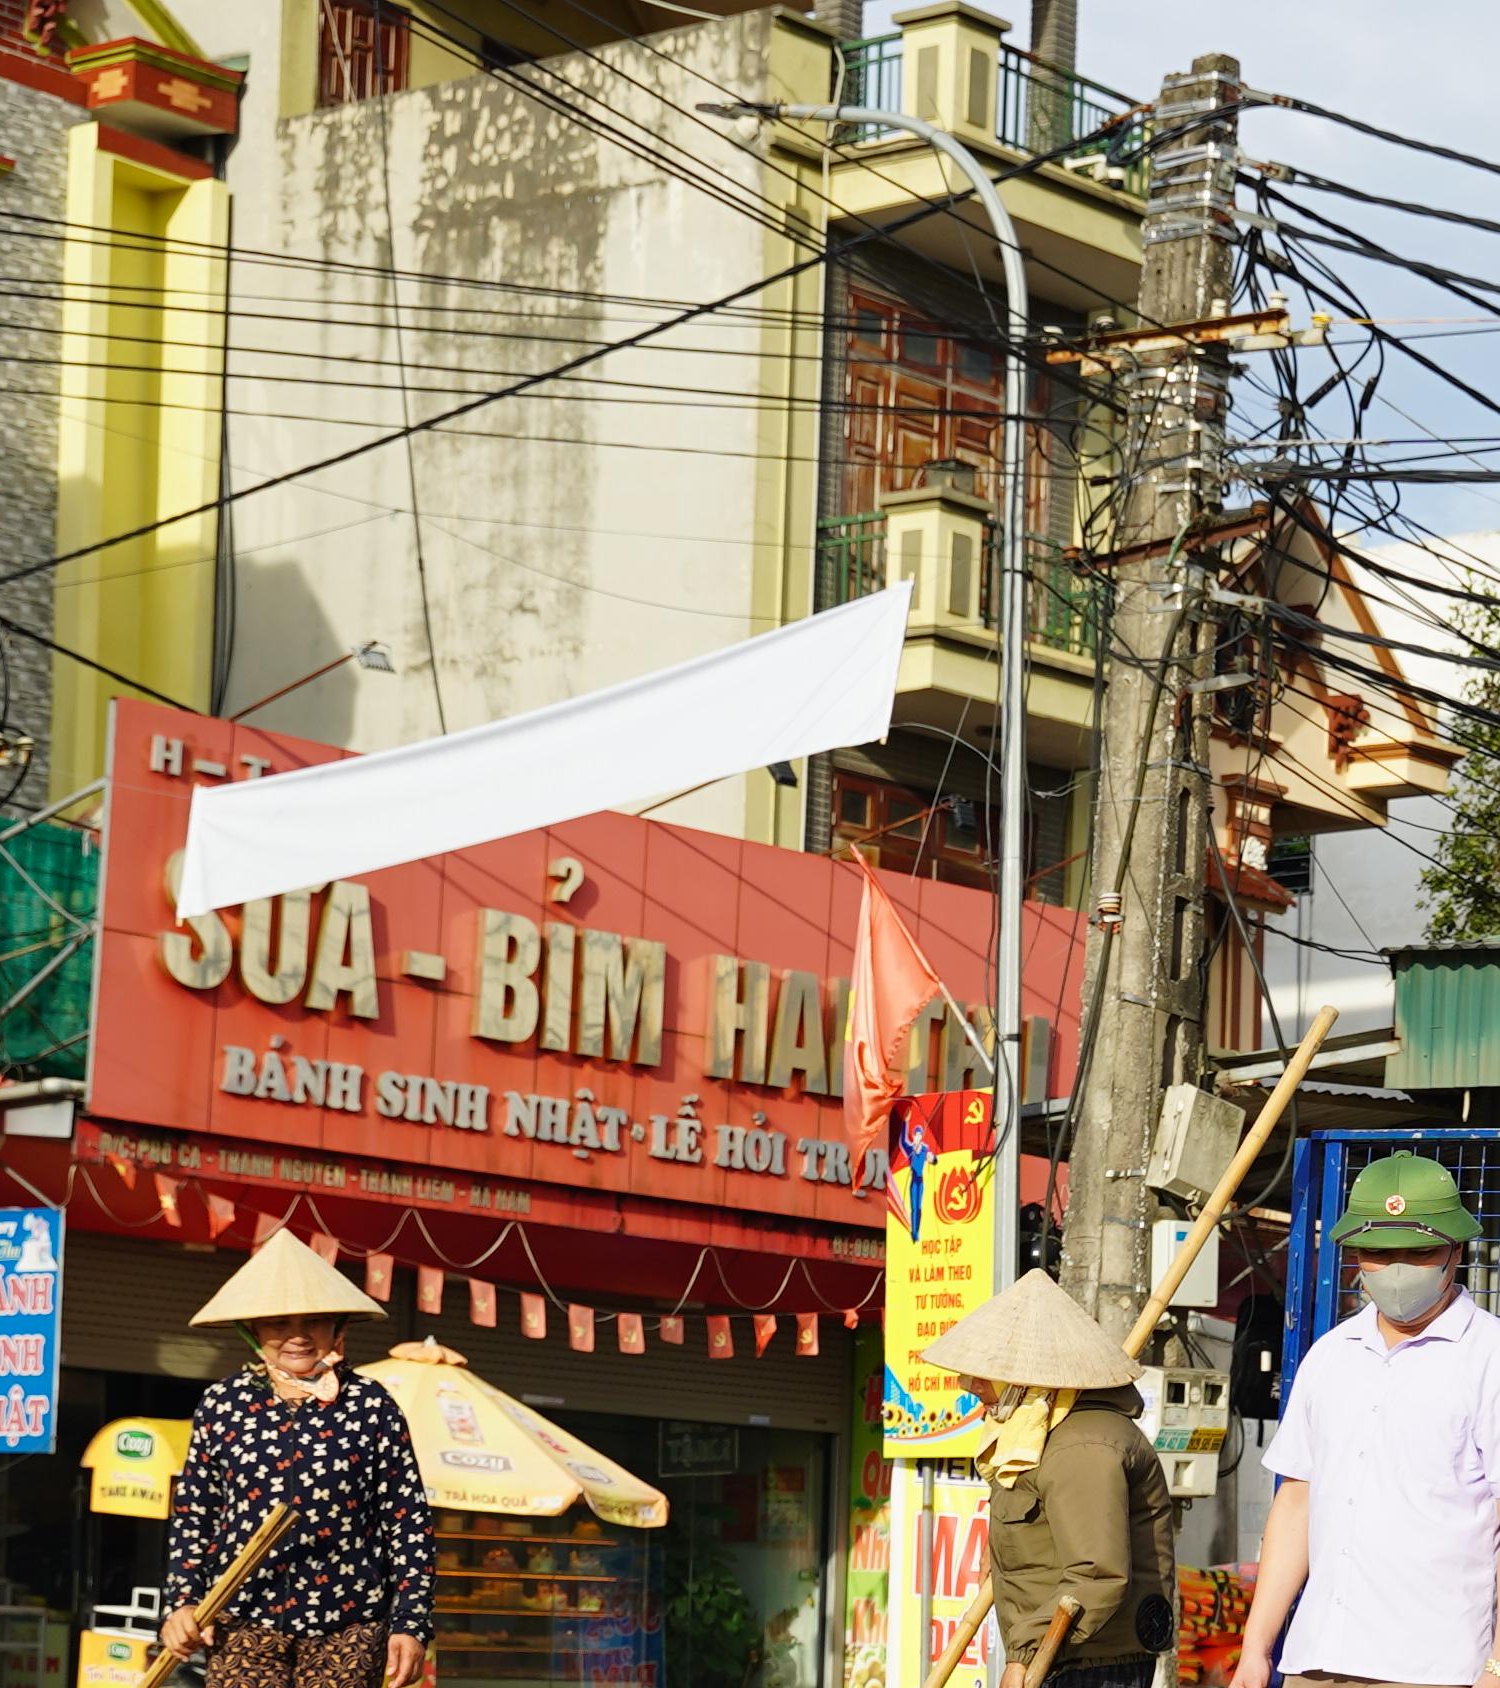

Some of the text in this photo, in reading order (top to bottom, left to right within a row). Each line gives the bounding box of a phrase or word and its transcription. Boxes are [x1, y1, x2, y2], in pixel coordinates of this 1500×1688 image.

[471, 856, 666, 1067] BỈM
[220, 1033, 363, 1113] BÁNH
[375, 1070, 490, 1132] SINH
[503, 1088, 627, 1159] NHẬT
[908, 1263, 972, 1281] VÀ LÀM THEO
[921, 1237, 962, 1259] HỌC TẬP
